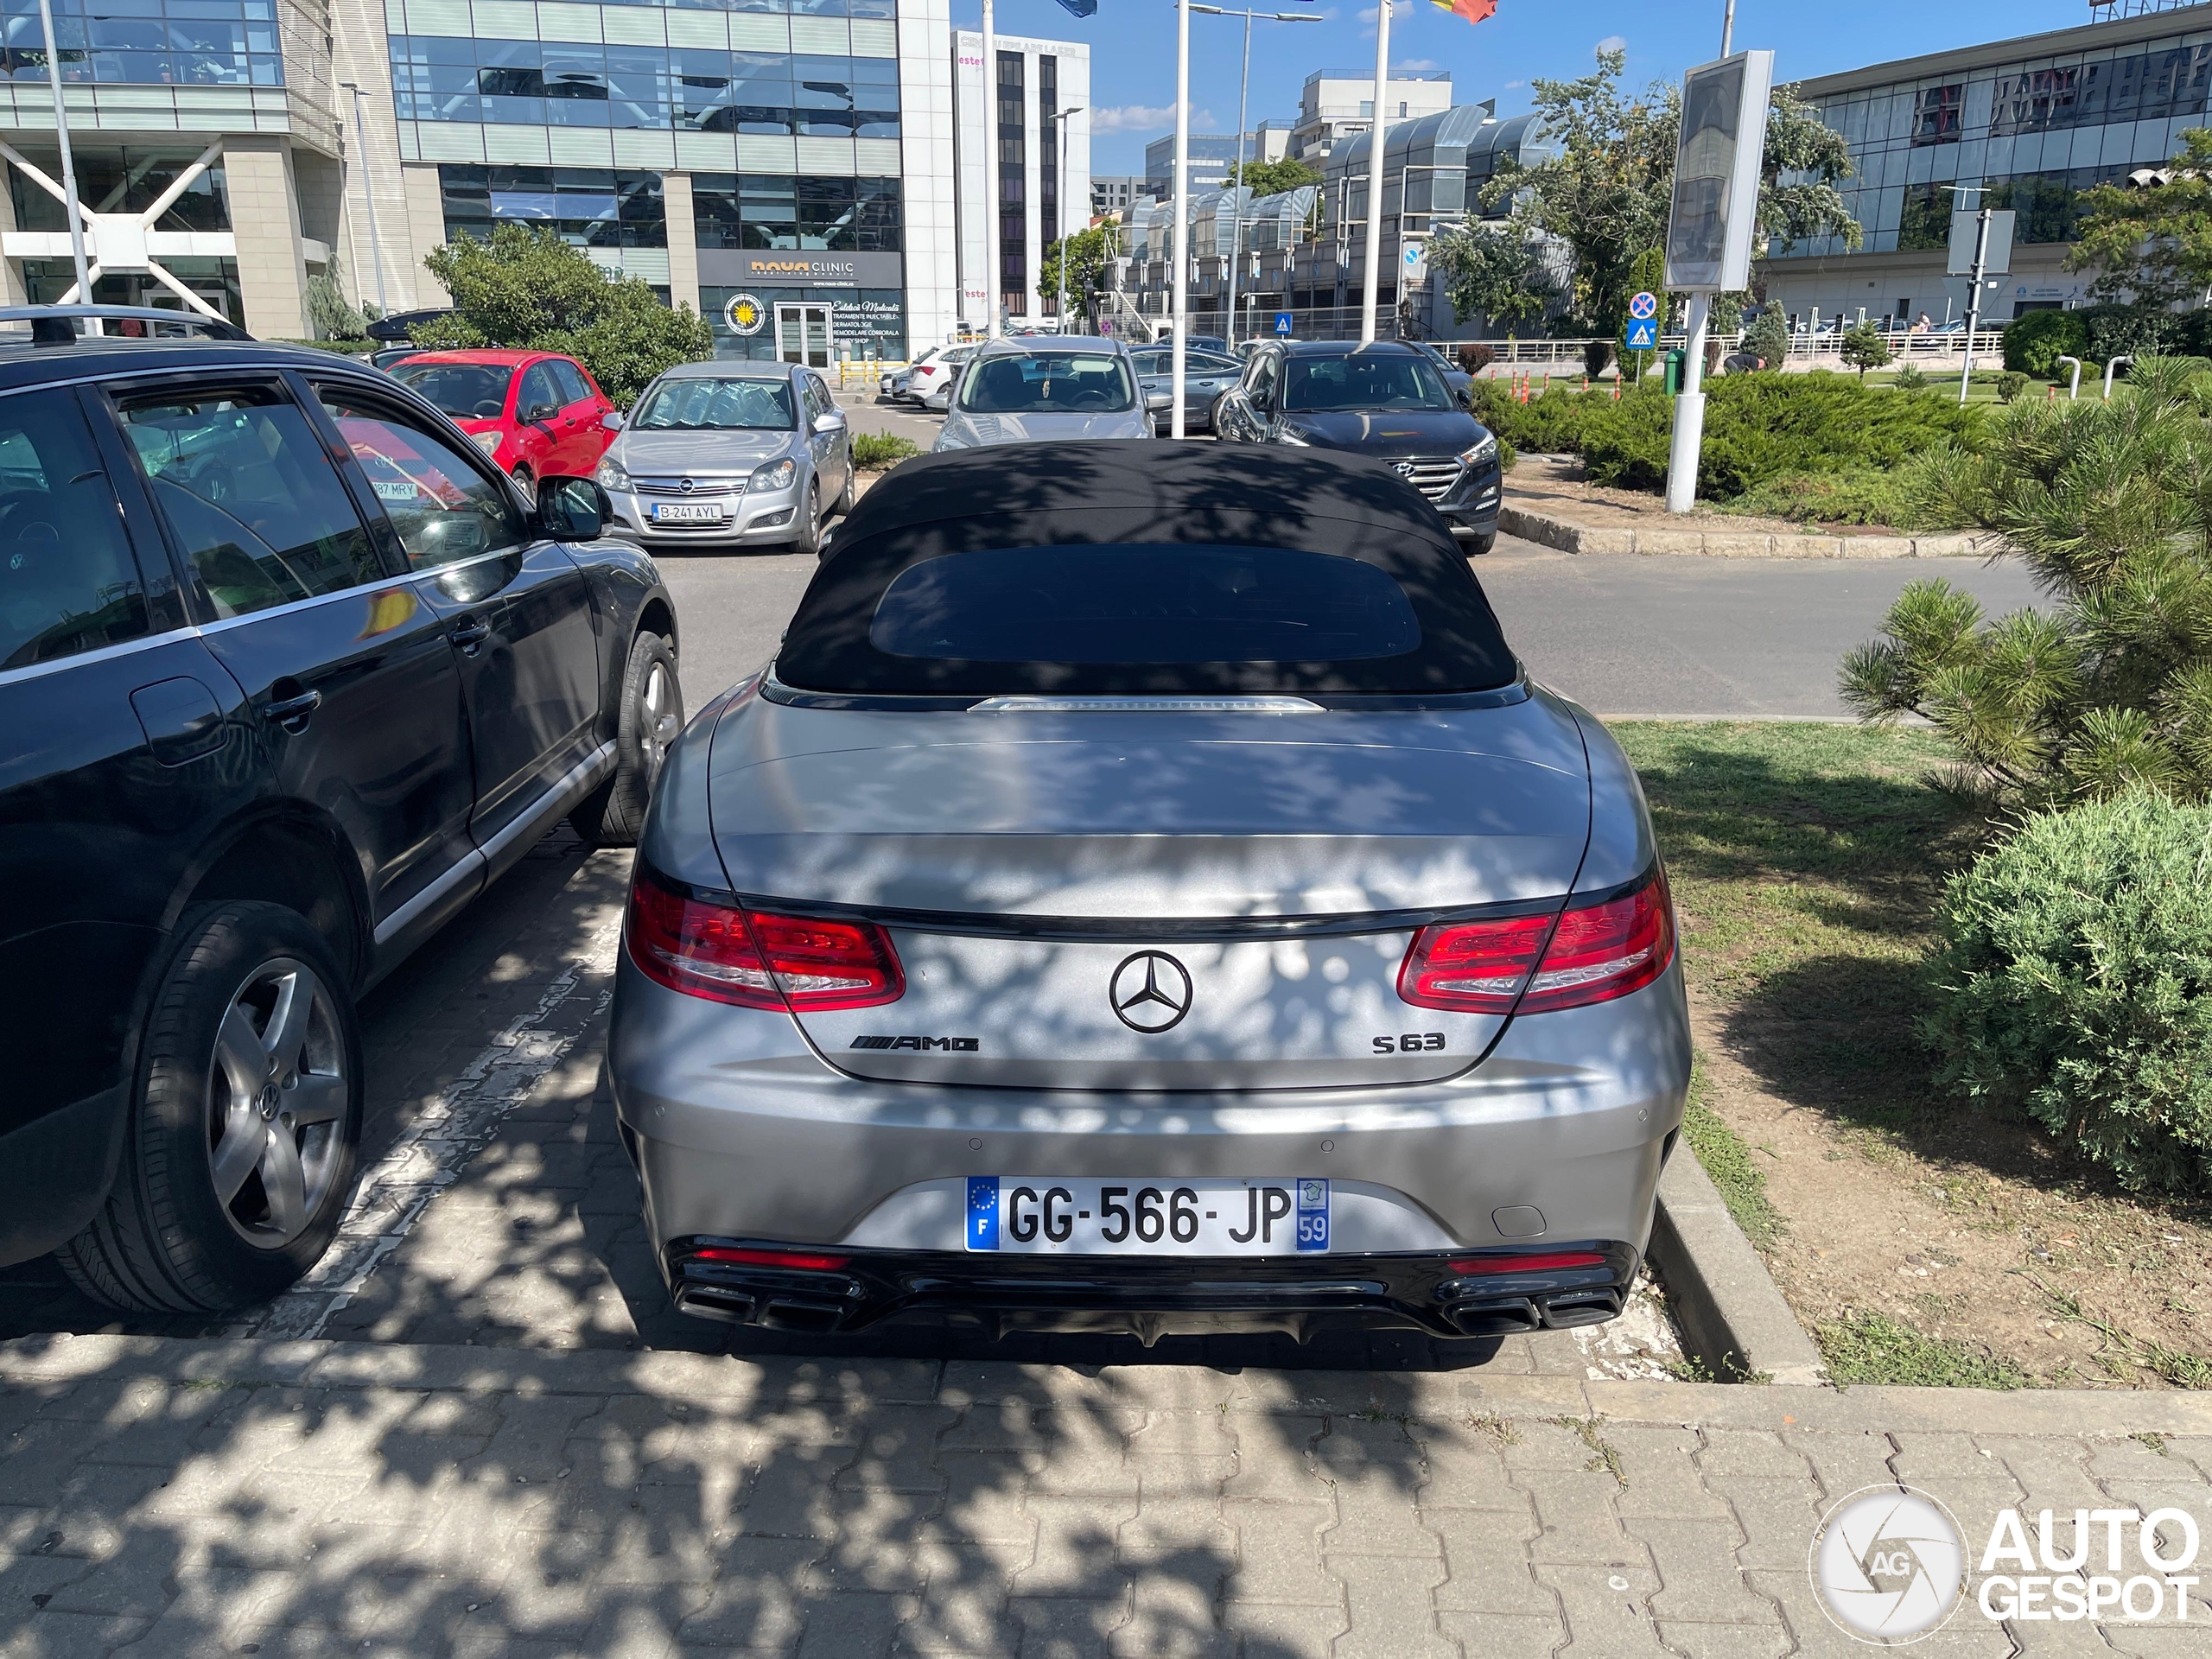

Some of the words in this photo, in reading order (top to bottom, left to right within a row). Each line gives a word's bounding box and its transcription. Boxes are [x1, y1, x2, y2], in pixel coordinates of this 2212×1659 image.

[960, 35, 1001, 48] CENU
[811, 262, 854, 272] CLINIC
[391, 484, 413, 495] MRY
[696, 506, 718, 518] AYL
[890, 1036, 979, 1052] AMG
[1372, 1036, 1395, 1054] S
[1400, 1033, 1446, 1052] 63
[978, 1218, 988, 1236] F
[1299, 1216, 1326, 1242] 59
